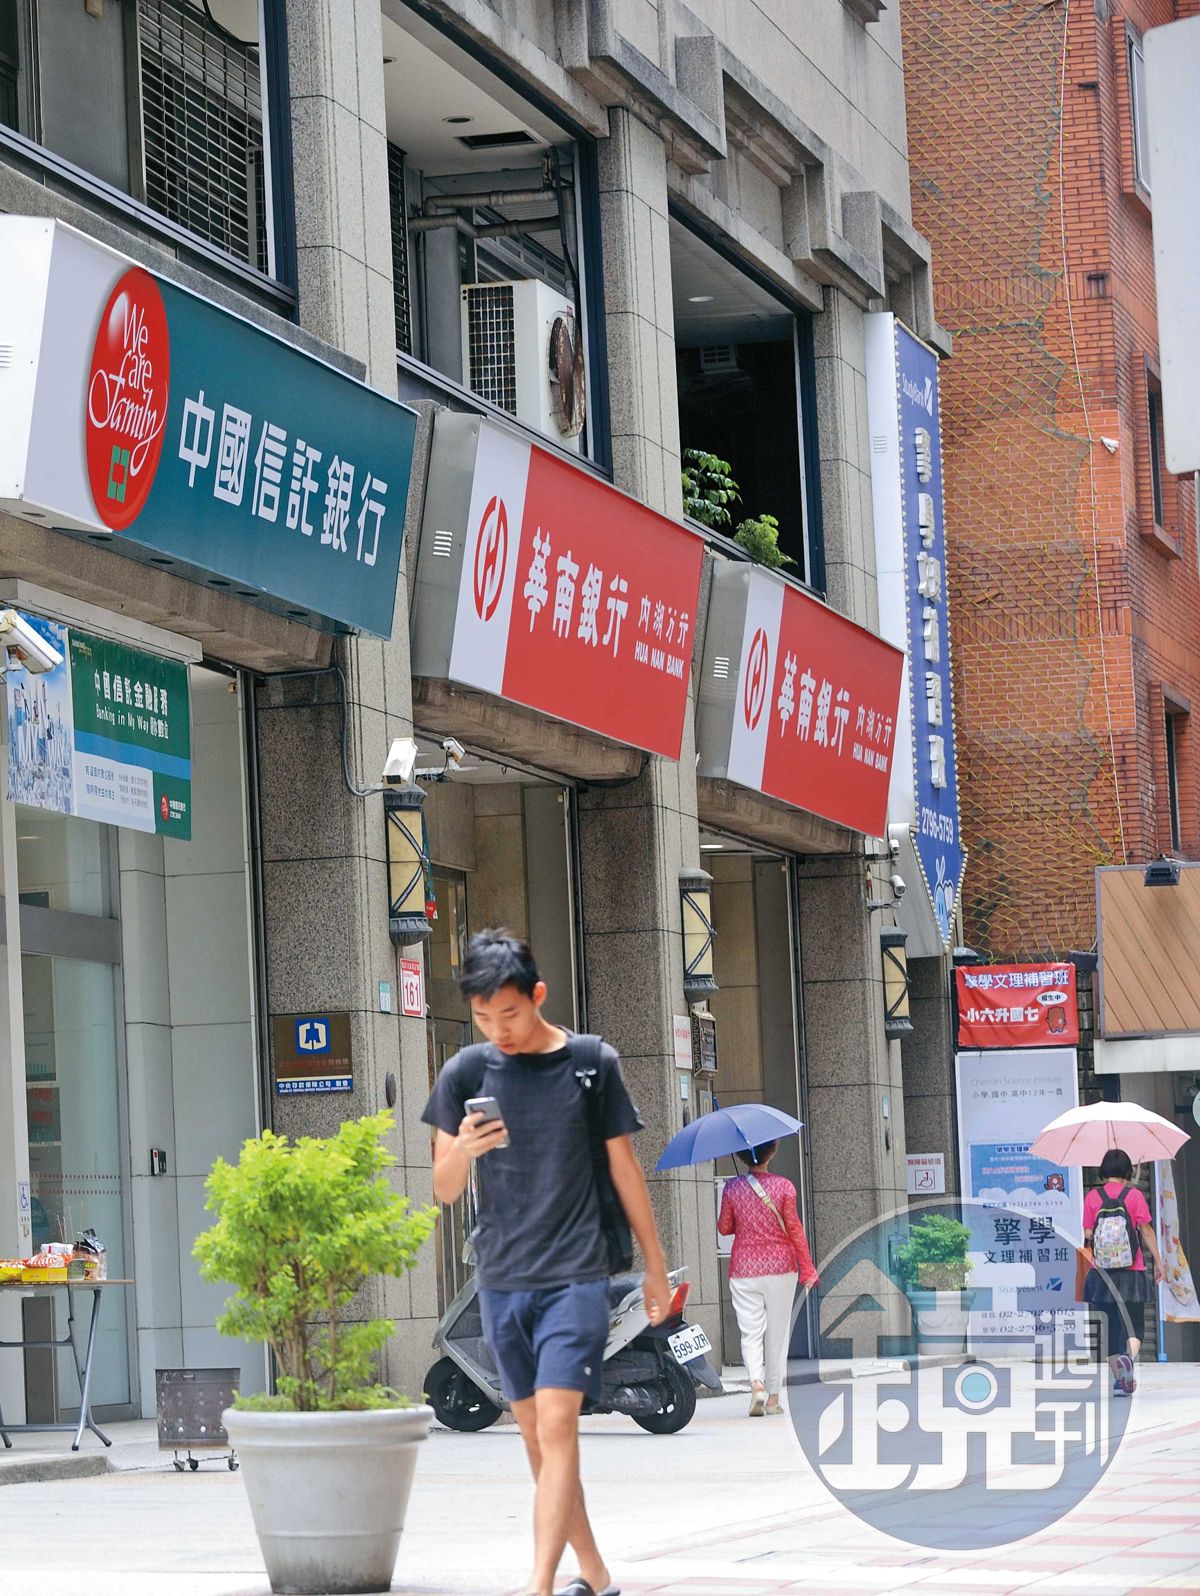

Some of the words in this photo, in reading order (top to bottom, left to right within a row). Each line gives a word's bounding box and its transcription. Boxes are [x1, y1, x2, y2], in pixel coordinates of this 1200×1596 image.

[178, 390, 388, 567] 中國信託銀行
[523, 526, 629, 658] 華南銀行
[638, 594, 689, 649] 內湖分行
[635, 640, 648, 664] HUA
[651, 647, 665, 671] NAN
[666, 654, 684, 679] BANK
[118, 710, 126, 726] in
[137, 715, 149, 734] Way
[777, 650, 850, 757] 華南銀行
[856, 704, 892, 748] 內湖分行
[875, 752, 888, 772] BANK
[921, 806, 953, 845] 2796-5759
[404, 982, 419, 1007] 161
[967, 1007, 1039, 1023] 小六升國七
[993, 1216, 1055, 1246] 擎學
[984, 1248, 1068, 1264] 文理補習班
